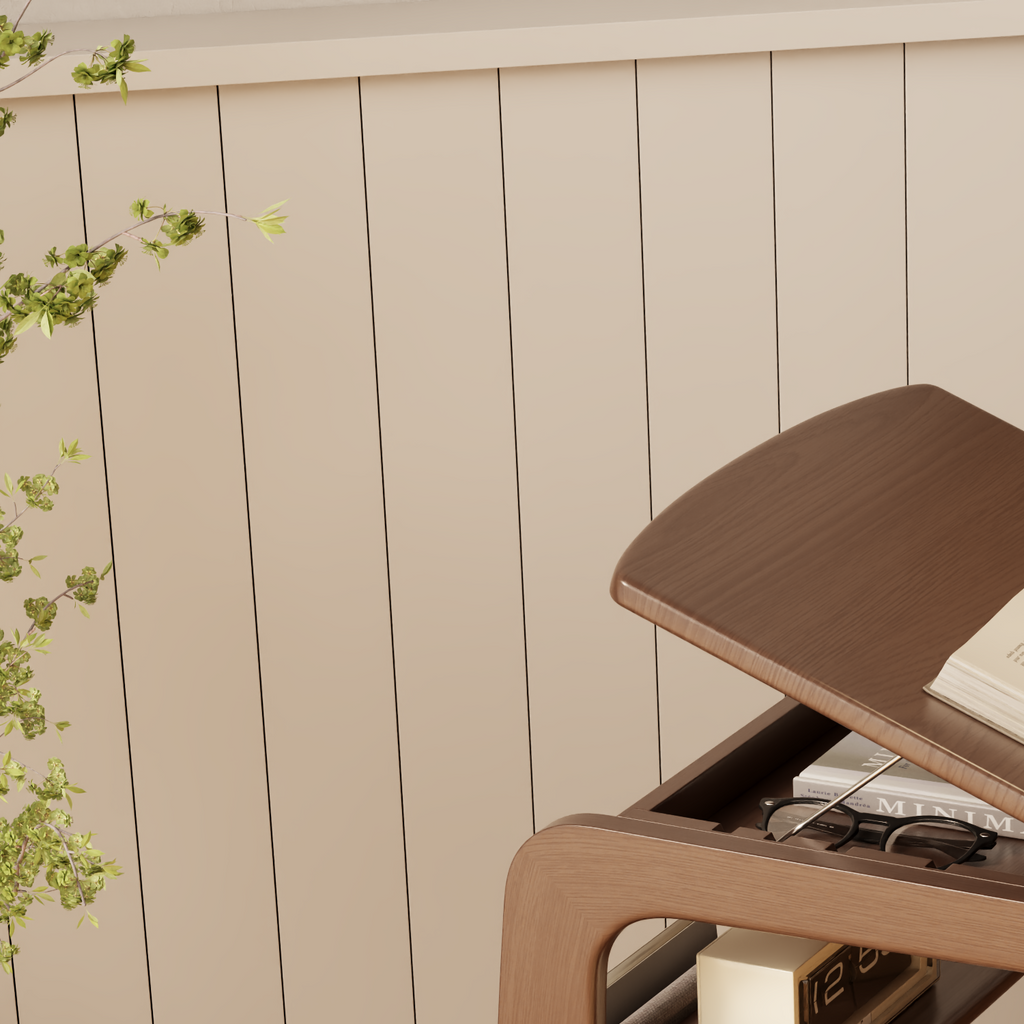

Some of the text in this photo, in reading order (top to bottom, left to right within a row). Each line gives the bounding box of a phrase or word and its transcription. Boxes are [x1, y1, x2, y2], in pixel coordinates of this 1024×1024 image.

[807, 788, 832, 796] Laurie
[833, 791, 864, 801] Bette
[813, 961, 845, 1015] 12
